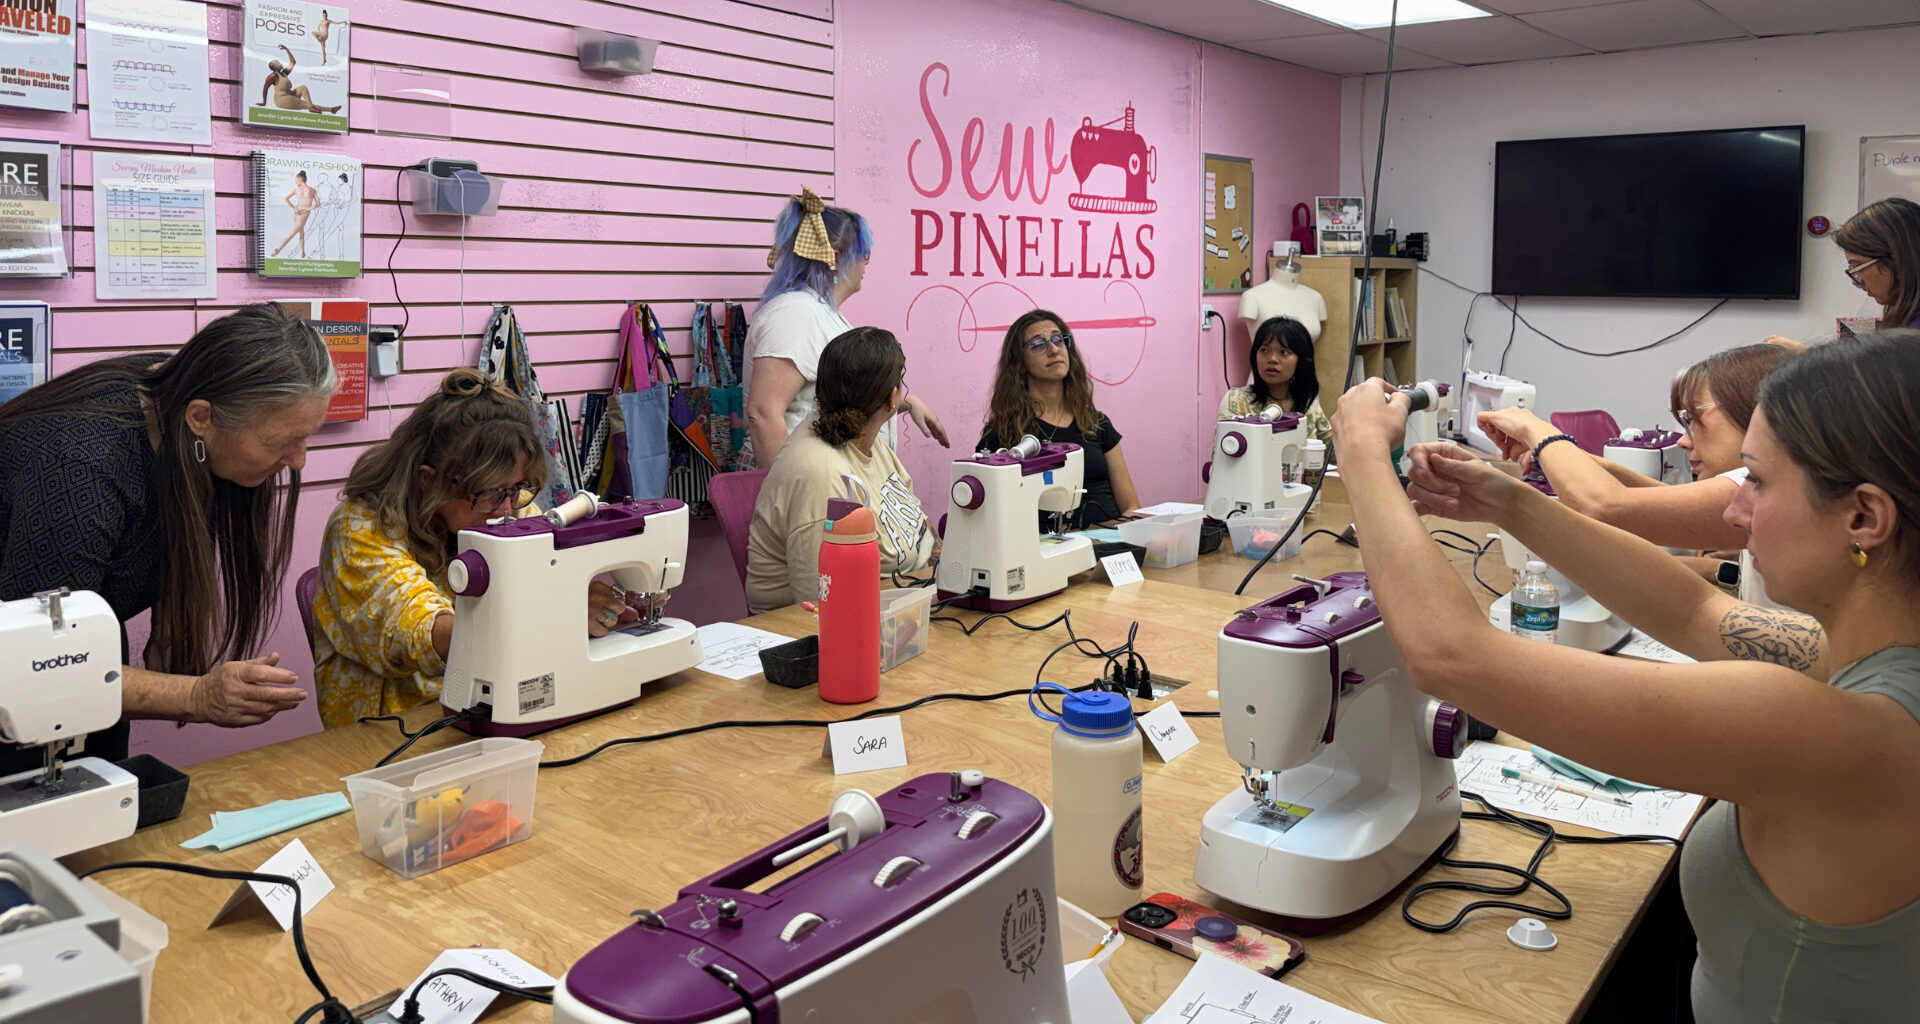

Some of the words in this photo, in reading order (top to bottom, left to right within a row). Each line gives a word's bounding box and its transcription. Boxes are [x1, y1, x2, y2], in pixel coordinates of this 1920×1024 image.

[257, 4, 288, 14] FASHION
[260, 11, 302, 22] EXPRESSIVE
[256, 18, 306, 36] POSES
[0, 67, 16, 76] and
[18, 68, 50, 80] Manage
[52, 73, 70, 82] Your
[2, 76, 31, 86] Design
[32, 79, 70, 91] Business
[907, 61, 1068, 205] Sew
[312, 162, 357, 172] FASHION
[1873, 152, 1909, 167] Purple
[132, 173, 152, 184] SIZE
[154, 174, 180, 184] GUIDE
[909, 208, 1156, 280] PINELLAS
[326, 326, 360, 334] DESIGN
[32, 652, 90, 672] brother
[853, 736, 887, 754] SARA
[1012, 906, 1036, 940] 100
